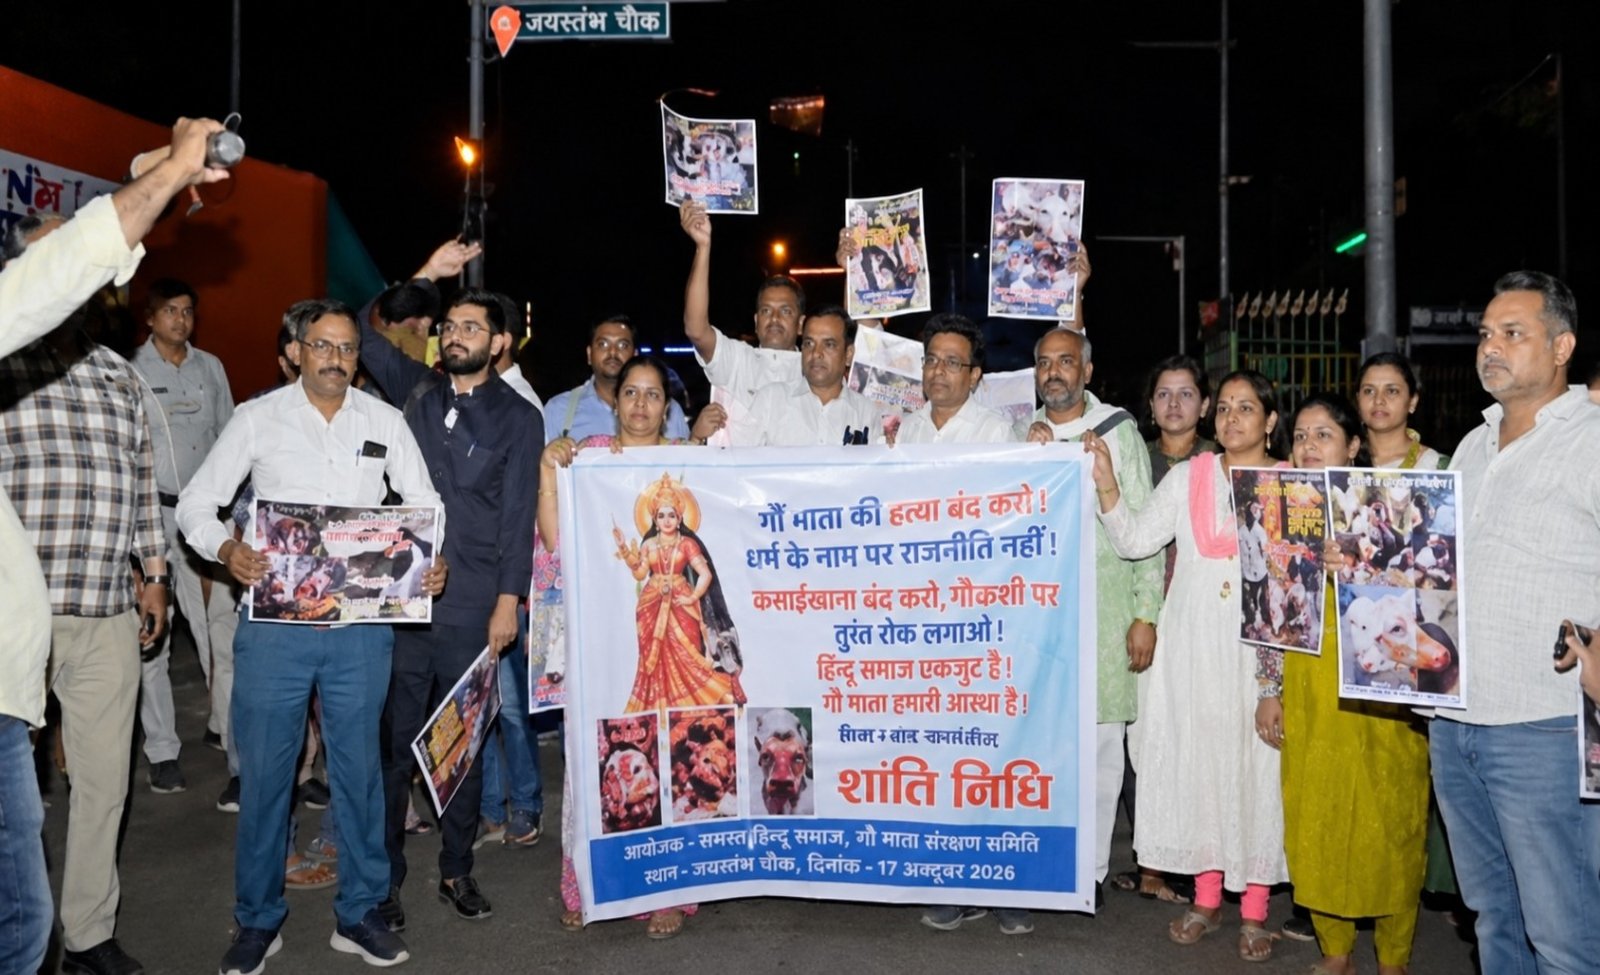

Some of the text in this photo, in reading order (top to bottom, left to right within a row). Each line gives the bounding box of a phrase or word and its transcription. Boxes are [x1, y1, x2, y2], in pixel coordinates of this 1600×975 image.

[526, 4, 660, 33] जयस्तंभ चौक
[849, 496, 882, 527] की
[888, 499, 940, 526] हत्या
[946, 490, 981, 519] बंद
[746, 541, 780, 570] धर्म
[784, 541, 809, 569] के
[814, 546, 858, 568] नाम
[863, 544, 894, 566] पर
[899, 529, 994, 564] राजनीति
[752, 583, 857, 614] कसाईखाना
[861, 582, 893, 611] बंद
[949, 576, 1025, 608] गौकशी
[1031, 583, 1060, 606] पर
[833, 618, 873, 653] तुरंत
[877, 617, 917, 645] रोक
[859, 660, 914, 680] समाज
[919, 657, 983, 687] एकजुट
[822, 687, 843, 714] गौ
[848, 694, 888, 714] माता
[892, 686, 940, 715] हमारी
[946, 692, 1000, 714] आस्था
[837, 755, 1053, 810] शांति निधि
[624, 836, 684, 861] आयोजक
[699, 830, 748, 849] समस्त
[752, 824, 791, 850] हिन्दू
[794, 828, 850, 848] समाज,
[856, 824, 876, 847] गौ
[881, 831, 919, 849] माता
[924, 830, 981, 852] संरक्षण
[986, 831, 1040, 852] समिति
[644, 865, 678, 885] स्थान
[692, 853, 755, 876] जयस्तंभ
[759, 851, 801, 875] चौक,
[807, 853, 861, 874] दिनांक
[878, 860, 898, 876] 17
[970, 865, 1016, 881] 2026
